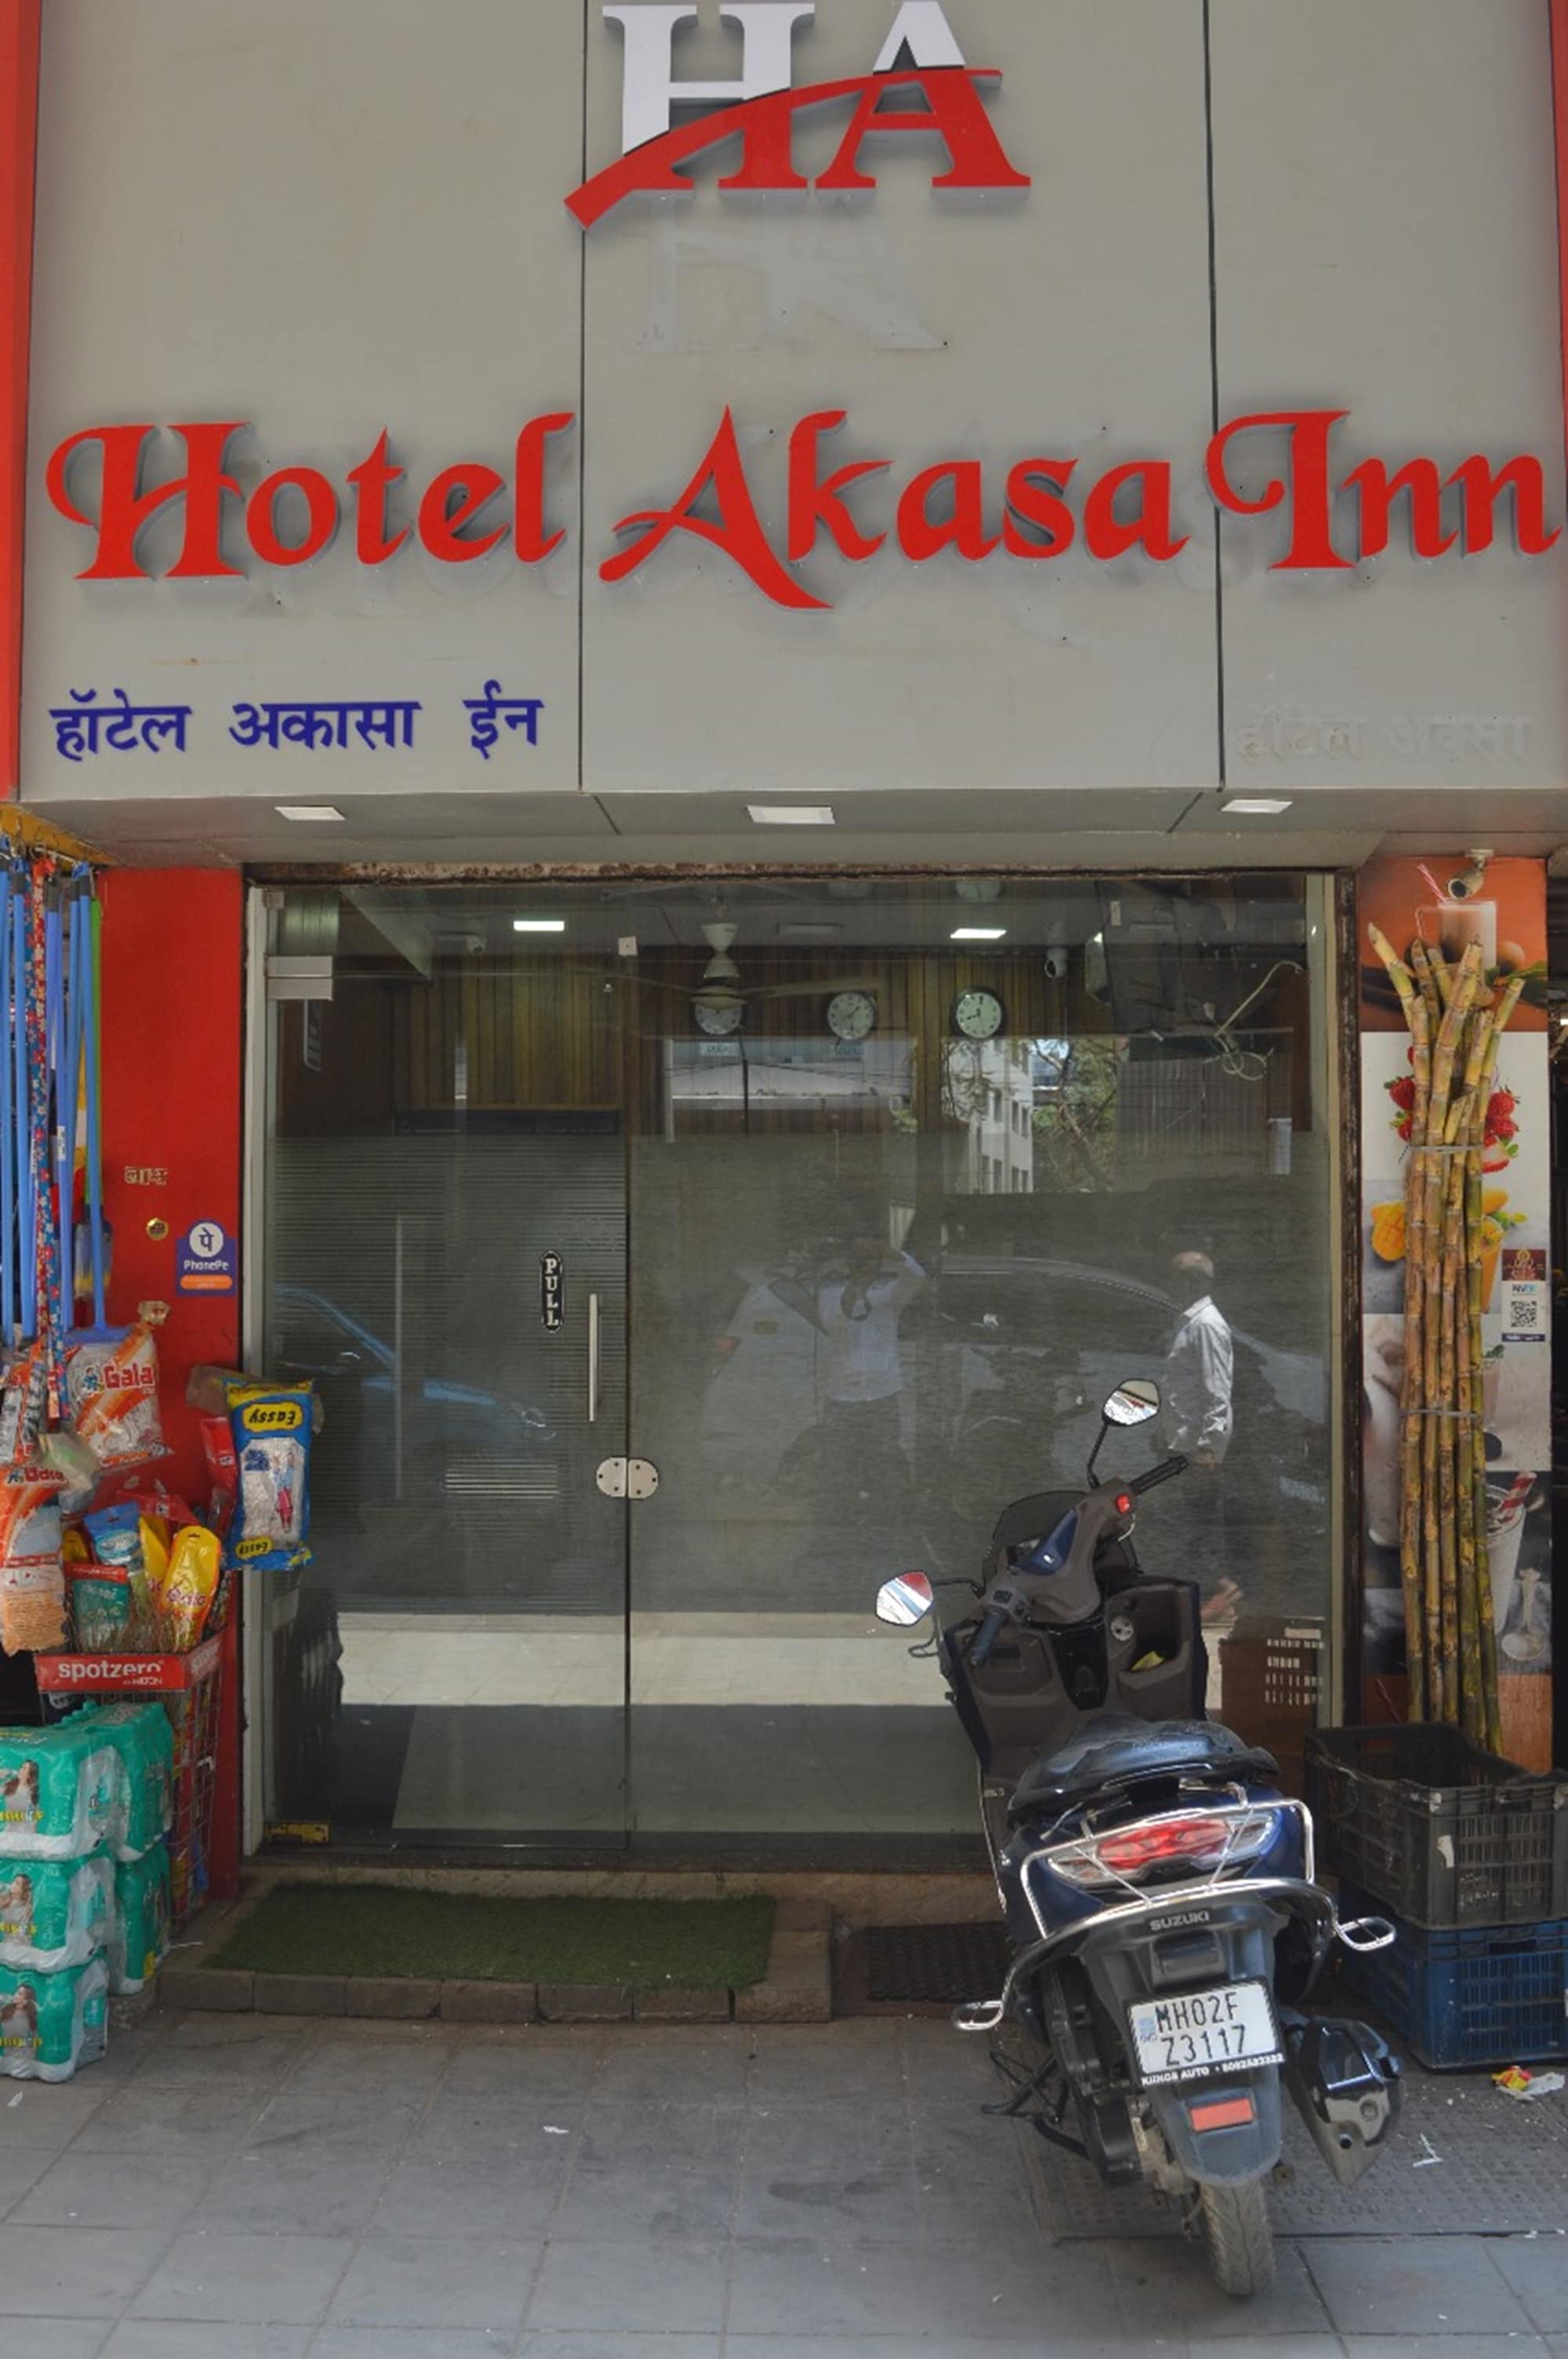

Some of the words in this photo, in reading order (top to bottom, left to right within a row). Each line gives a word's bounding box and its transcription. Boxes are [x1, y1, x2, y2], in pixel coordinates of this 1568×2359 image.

[45, 413, 574, 580] Hotel
[600, 407, 1189, 609] Akasa
[1207, 410, 1561, 569] Inn
[50, 689, 192, 762] हॉटेल
[230, 701, 421, 751] अकासा
[463, 679, 544, 761] ईन
[183, 1259, 230, 1271] PhonePe
[545, 1257, 559, 1326] PULL
[103, 1363, 154, 1389] Gala
[249, 1411, 296, 1426] Eassy
[58, 1659, 162, 1683] spotzero
[1149, 1910, 1210, 1932] SUZUKI
[1154, 1991, 1239, 2034] MH02F
[1161, 2023, 1246, 2067] Z3117
[1180, 2066, 1210, 2080] AUTO
